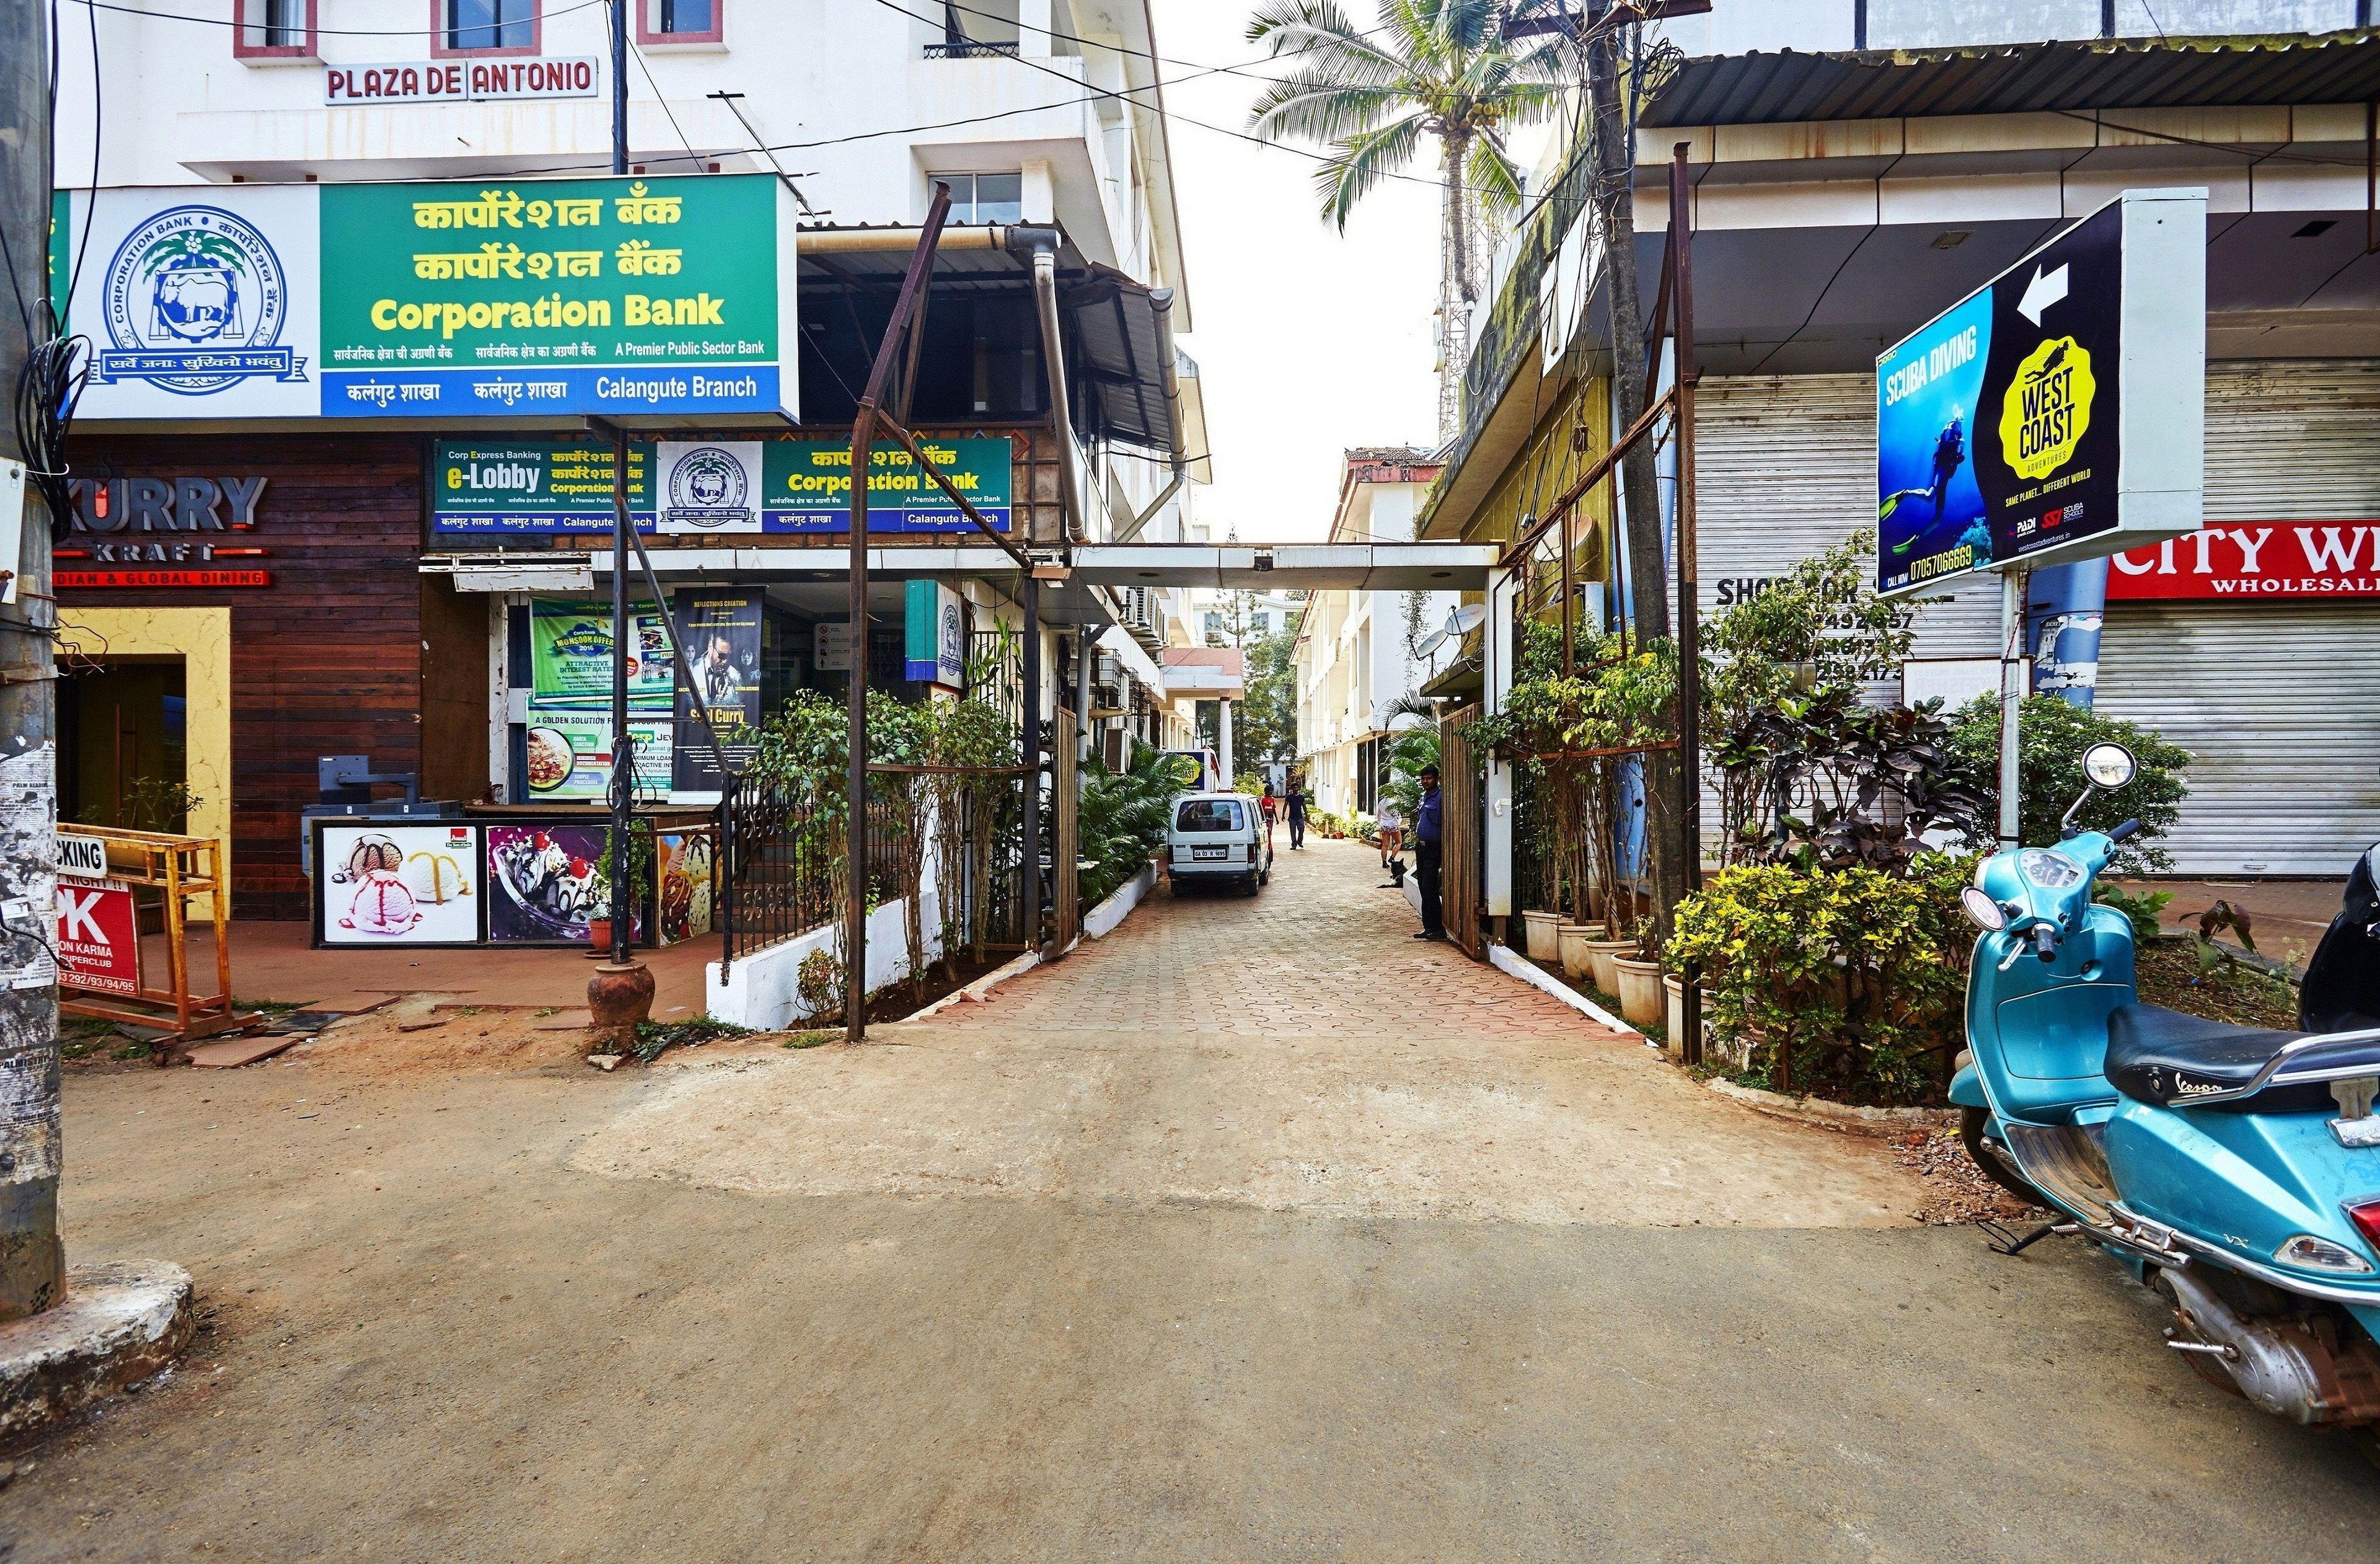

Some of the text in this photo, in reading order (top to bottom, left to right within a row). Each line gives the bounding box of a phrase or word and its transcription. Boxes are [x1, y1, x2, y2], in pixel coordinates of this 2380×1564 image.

[328, 61, 591, 99] PLAZA DE ANTONIO
[413, 190, 603, 229] कार्पोरेशन
[413, 239, 682, 280] कार्पोरेशन बैंक
[114, 216, 193, 324] CORPORATION BANK
[371, 292, 725, 339] Corporation Bank
[333, 345, 375, 361] सार्वजनिक
[396, 345, 407, 360] ची
[410, 344, 435, 360] अग्रणी
[438, 343, 453, 359] बँक
[475, 342, 597, 360] सार्वजनिक क्षेत्र का अग्रणी बैंक
[615, 340, 765, 356] A Premier Public Sector Bank
[109, 357, 138, 369] सर्वे
[182, 356, 241, 371] सुखिनो
[1886, 324, 1977, 407] SCUBA DIVING
[346, 378, 441, 408] कलंगुट शाखा
[473, 376, 568, 407] कलंगुट शाखा
[596, 374, 757, 404] Calangute Branch
[2022, 366, 2073, 422] WEST
[2020, 403, 2075, 459] COAST
[448, 450, 541, 461] Corp Express Banking
[2027, 451, 2066, 473] ADVENTURES
[447, 463, 540, 493] e-Lobby
[674, 452, 709, 497] CORPORATION BANK
[788, 471, 979, 495] Corpoation Bnk
[550, 483, 615, 495] Corporation
[2006, 494, 2019, 508] SAME
[2043, 475, 2069, 494] DIFFERENT
[2071, 468, 2091, 484] WORLD
[2063, 501, 2083, 514] SCUBA
[2063, 508, 2083, 519] SCHOOLS
[441, 515, 493, 529] कलंगुट शाखा
[502, 515, 555, 529] कलंगुट शाखा
[563, 517, 614, 529] Calangute
[778, 513, 832, 526] कलंगुट शाखा
[908, 514, 959, 526] Calangute
[2017, 517, 2036, 533] PADI
[2017, 529, 2036, 538] padi.com
[2018, 532, 2070, 552] westcoastadventures.in
[94, 542, 215, 562] KRAFT
[1887, 544, 1972, 588] CALL NOW 07057066669
[56, 572, 262, 585] DIAN & GLOBAL DINING
[556, 636, 614, 647] MONSOON OFFER
[715, 709, 744, 723] Curry
[627, 731, 653, 743] orp
[76, 942, 113, 958] KARMA
[61, 954, 112, 968] SUPERCLUB
[69, 973, 134, 992] 292/93/94/95
[2175, 1072, 2223, 1093] Vespa
[2223, 1233, 2249, 1249] VX
